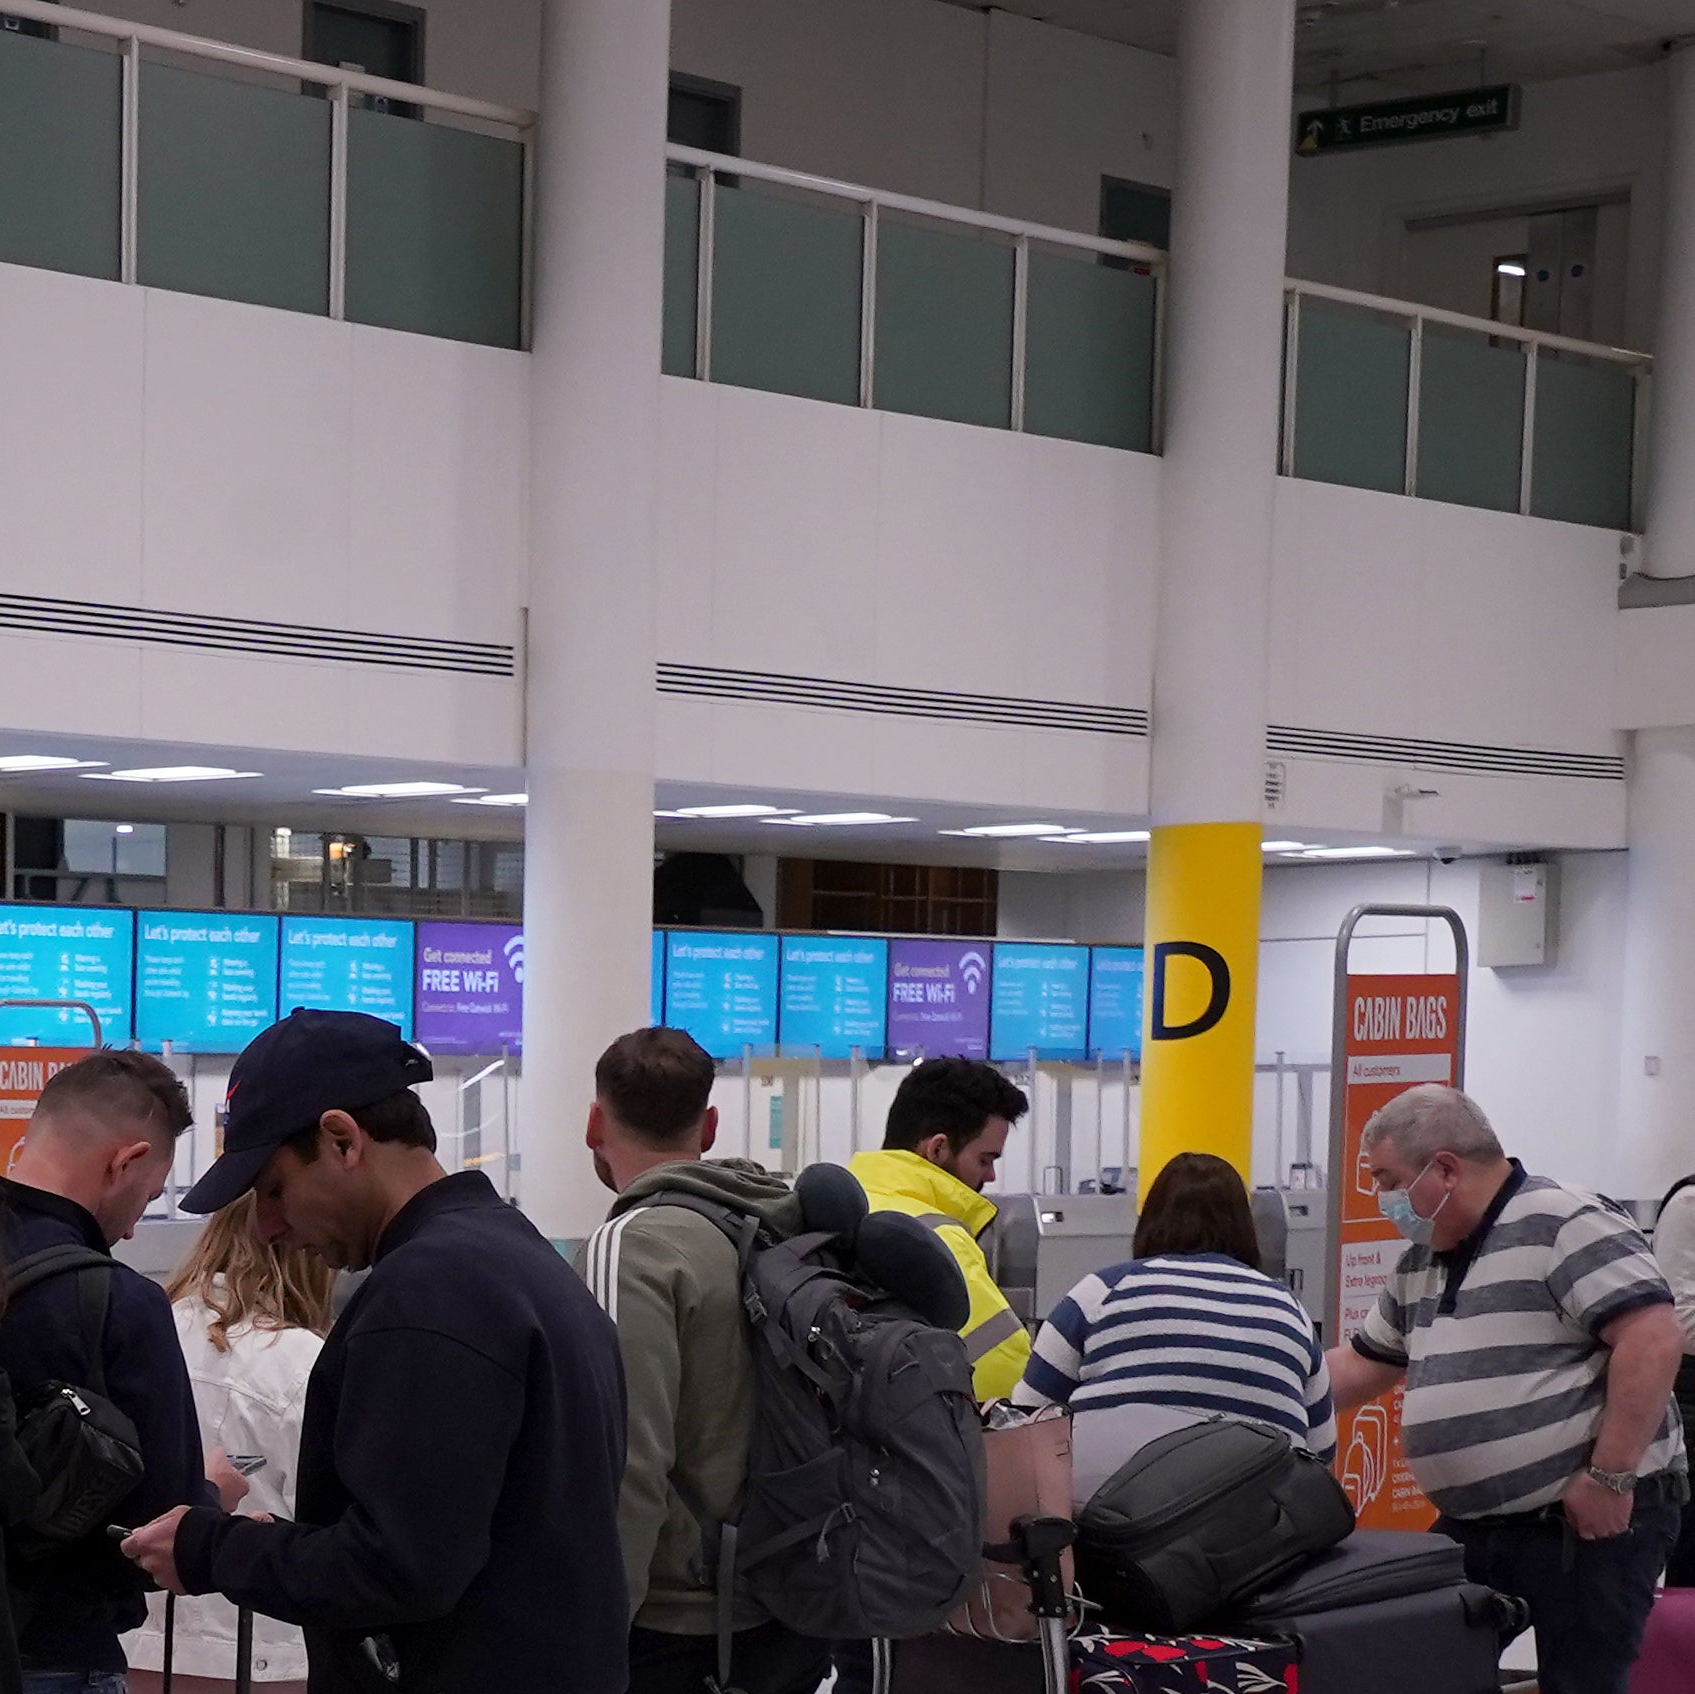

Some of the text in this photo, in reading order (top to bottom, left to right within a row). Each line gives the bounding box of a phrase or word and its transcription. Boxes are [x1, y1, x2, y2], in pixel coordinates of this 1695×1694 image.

[1361, 98, 1498, 133] Emergency exit
[422, 969, 500, 993] FREE Wi-Fi
[893, 982, 924, 1003] FREE
[1151, 940, 1231, 1041] D
[1353, 994, 1448, 1041] CABIN BAGS
